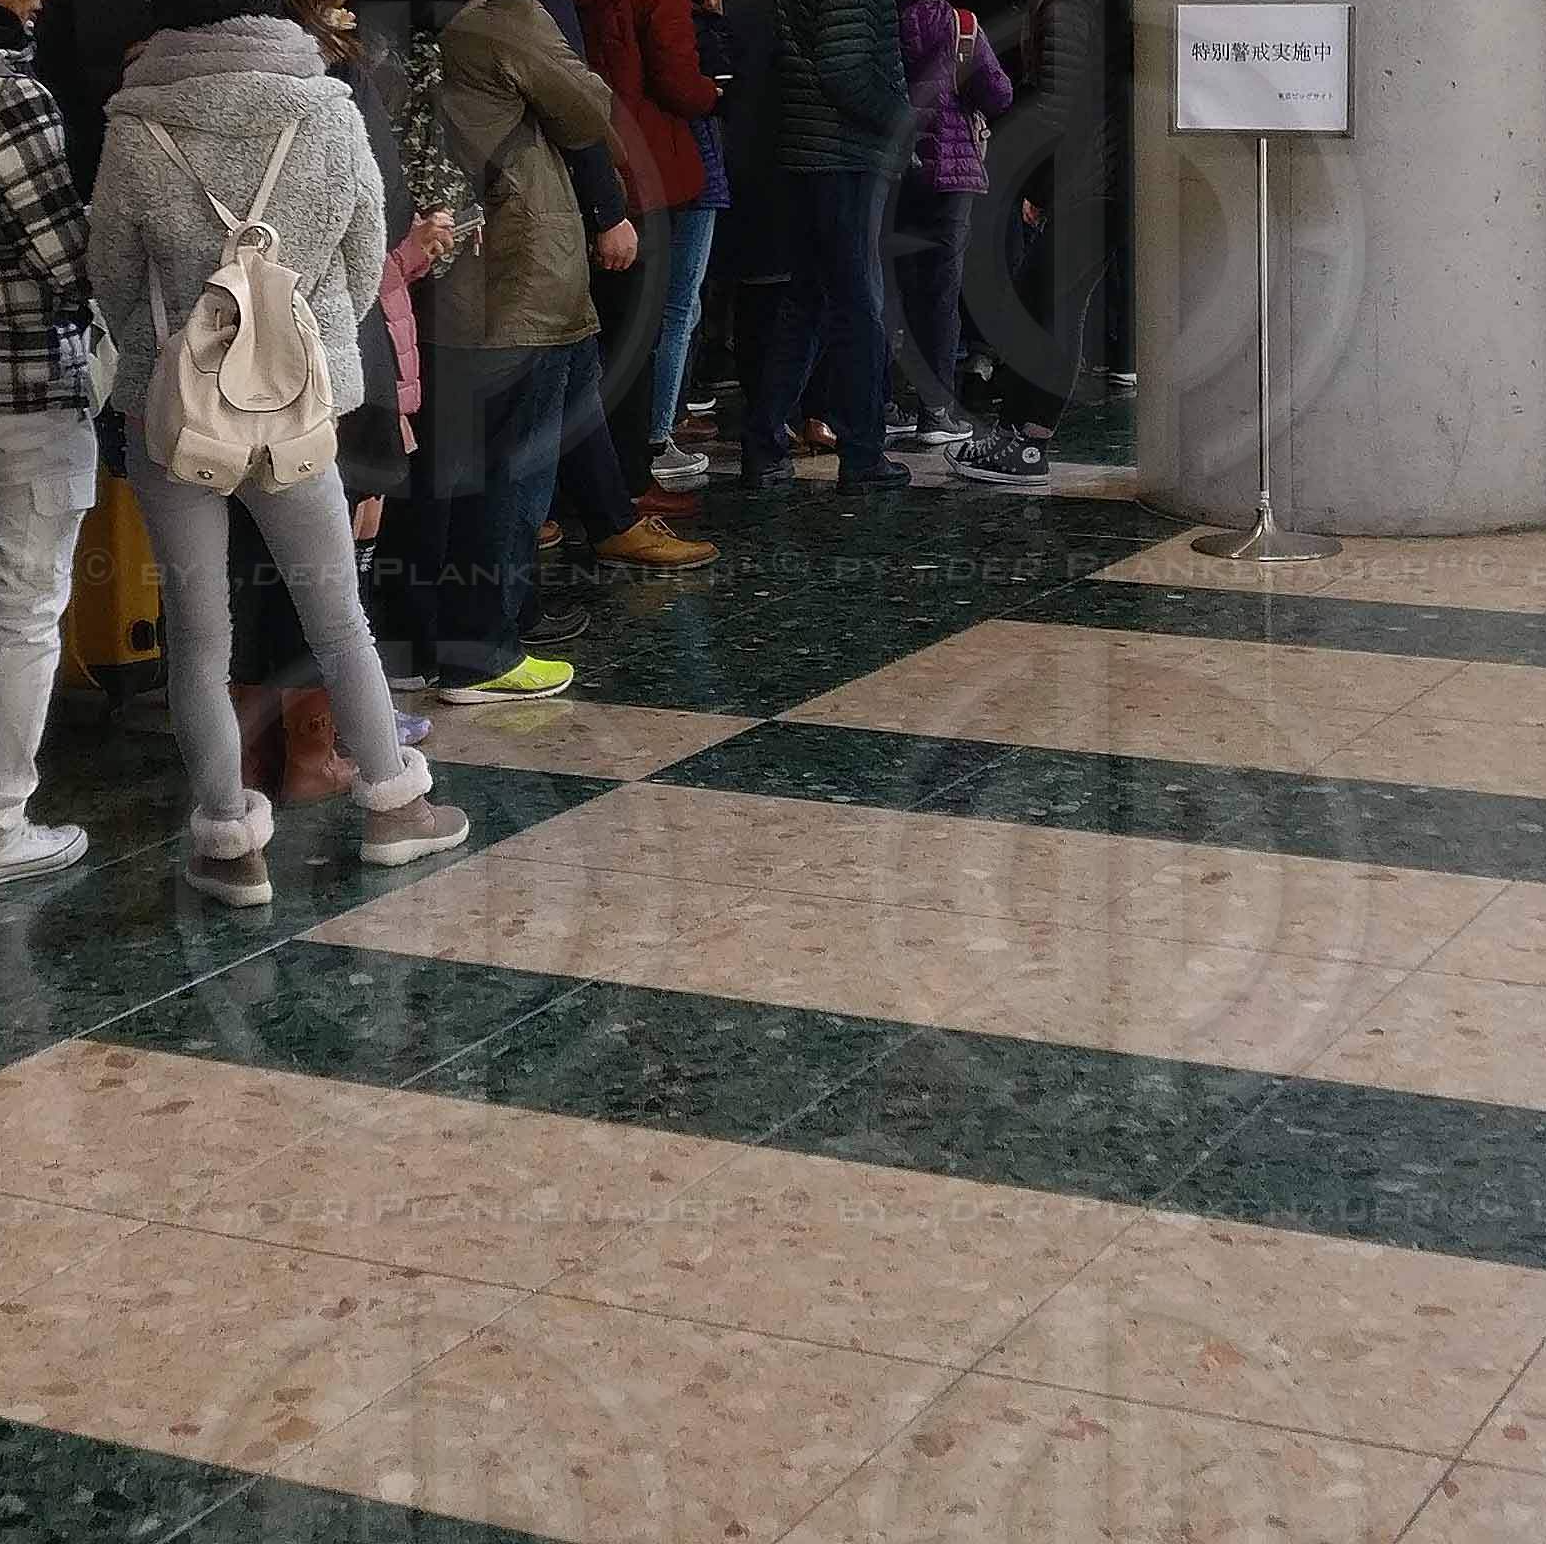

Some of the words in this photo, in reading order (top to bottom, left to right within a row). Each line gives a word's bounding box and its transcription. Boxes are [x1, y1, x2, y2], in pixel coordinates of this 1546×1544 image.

[1191, 41, 1333, 63] 特別警戒実施中
